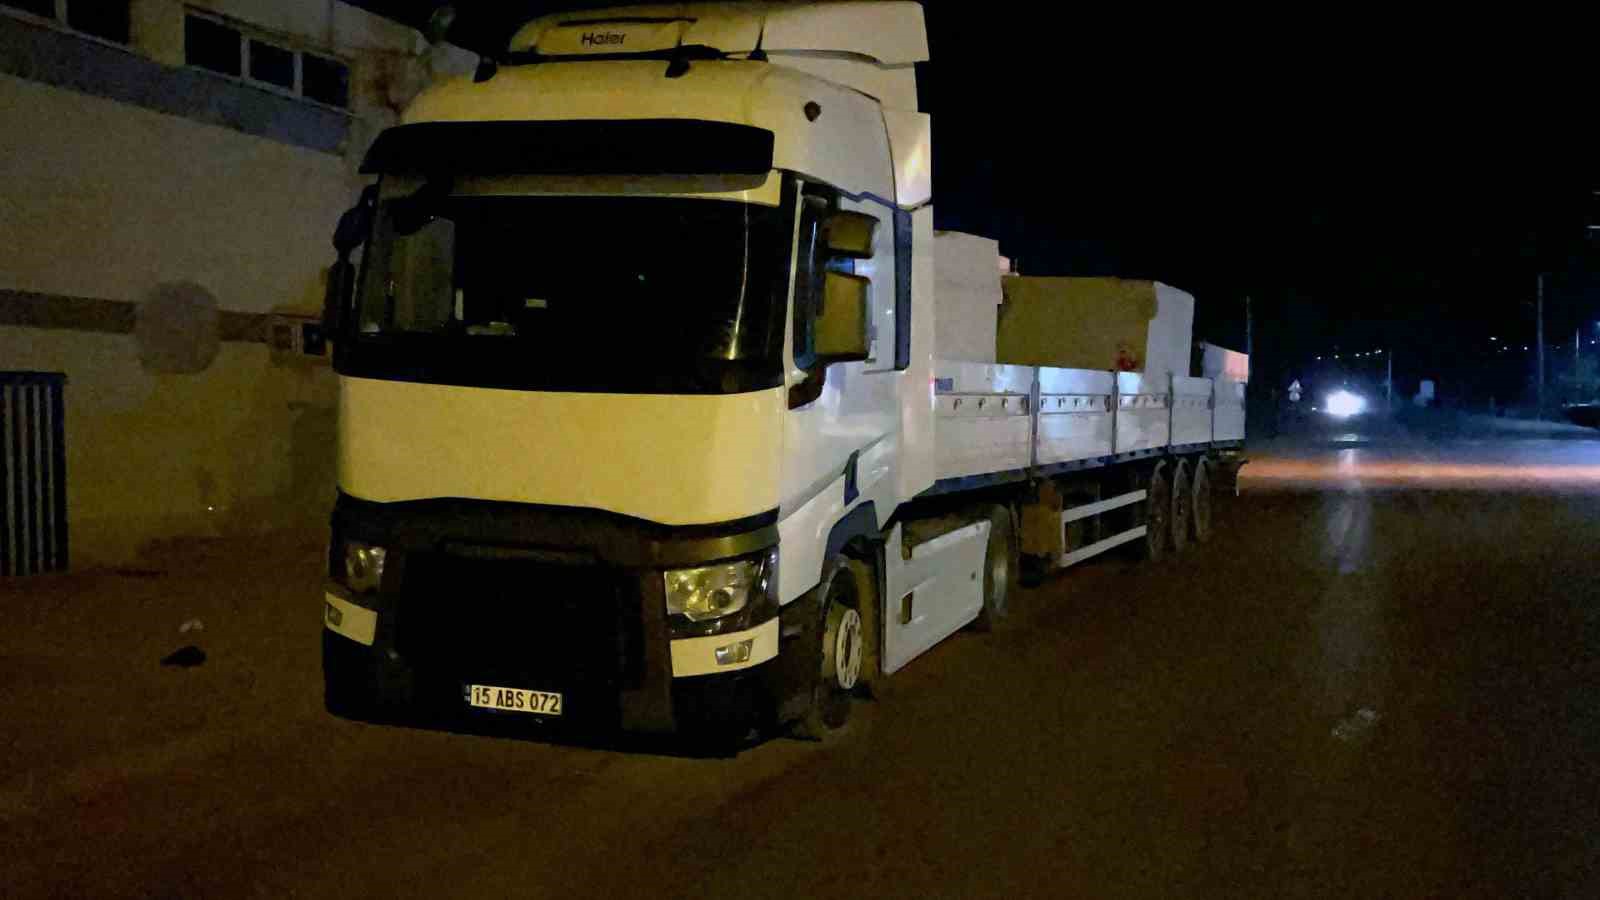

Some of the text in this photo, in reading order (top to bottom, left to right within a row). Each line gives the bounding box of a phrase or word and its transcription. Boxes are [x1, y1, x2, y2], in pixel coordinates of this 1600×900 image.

[581, 31, 626, 46] Haier
[473, 687, 559, 712] 15 ABS 072
